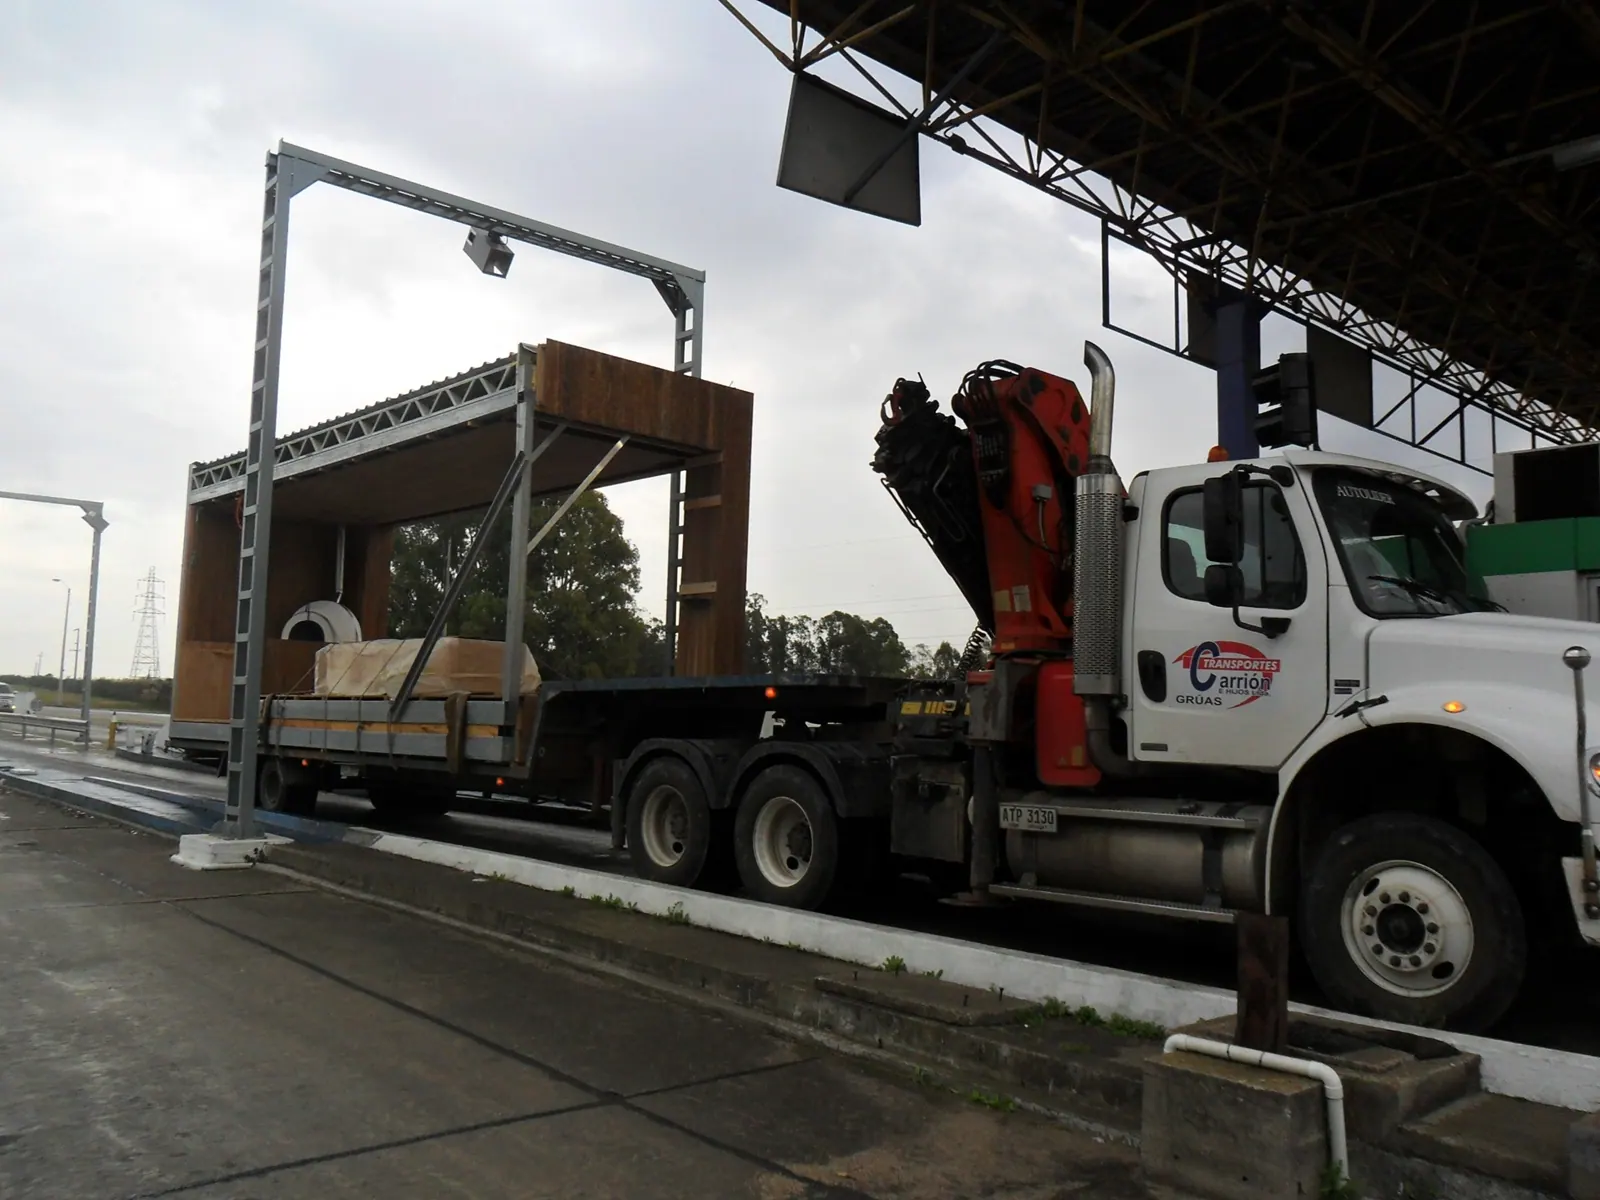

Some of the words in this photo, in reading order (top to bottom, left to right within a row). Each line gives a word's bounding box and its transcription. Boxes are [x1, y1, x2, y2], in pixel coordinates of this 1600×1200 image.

[1203, 659, 1277, 671] TRANSPORTES
[1176, 694, 1222, 706] GRÚAS
[1002, 808, 1022, 822] ATP
[1027, 809, 1054, 825] 3130
